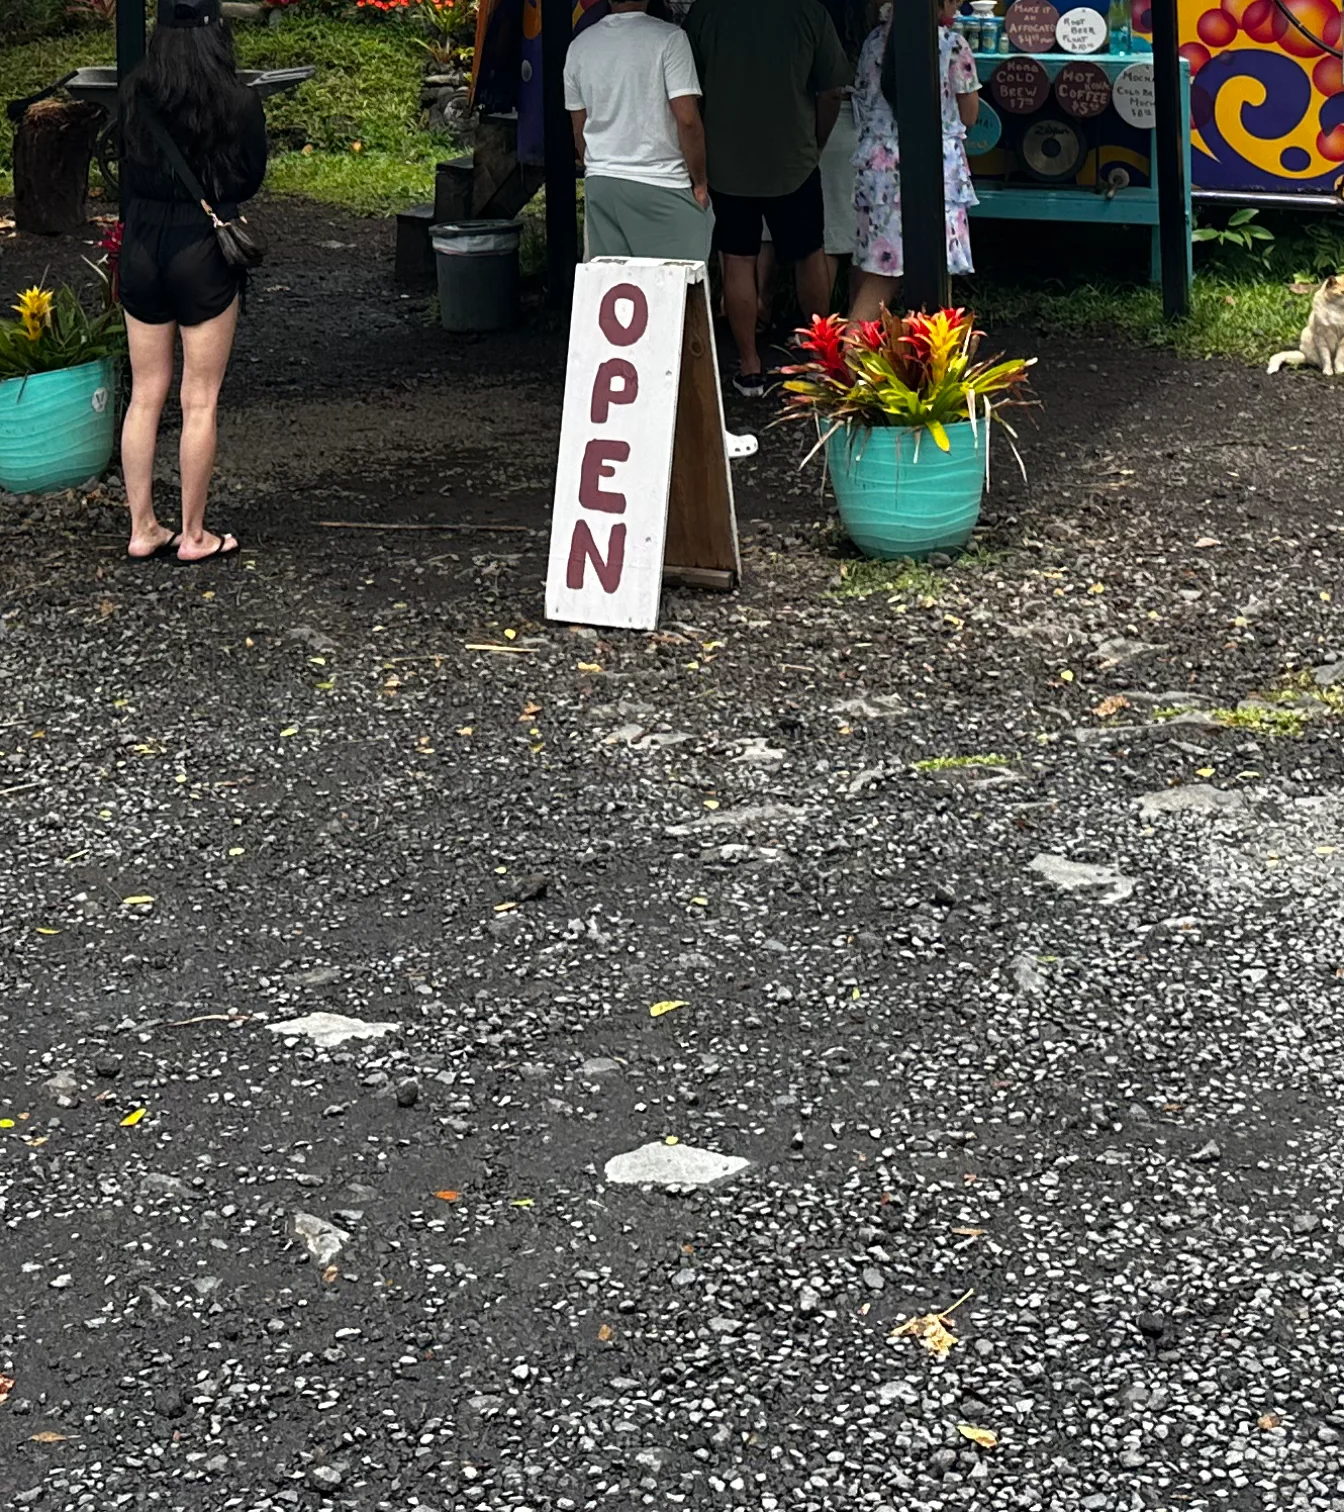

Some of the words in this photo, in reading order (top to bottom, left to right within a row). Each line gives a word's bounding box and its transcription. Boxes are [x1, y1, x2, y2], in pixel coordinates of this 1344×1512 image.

[1042, 6, 1051, 14] IT
[1071, 27, 1096, 35] BEER
[996, 71, 1034, 83] COLD
[1063, 69, 1095, 84] HOT
[1000, 85, 1037, 97] BREW
[1058, 84, 1107, 104] COFFEE
[566, 282, 649, 595] OPEN
